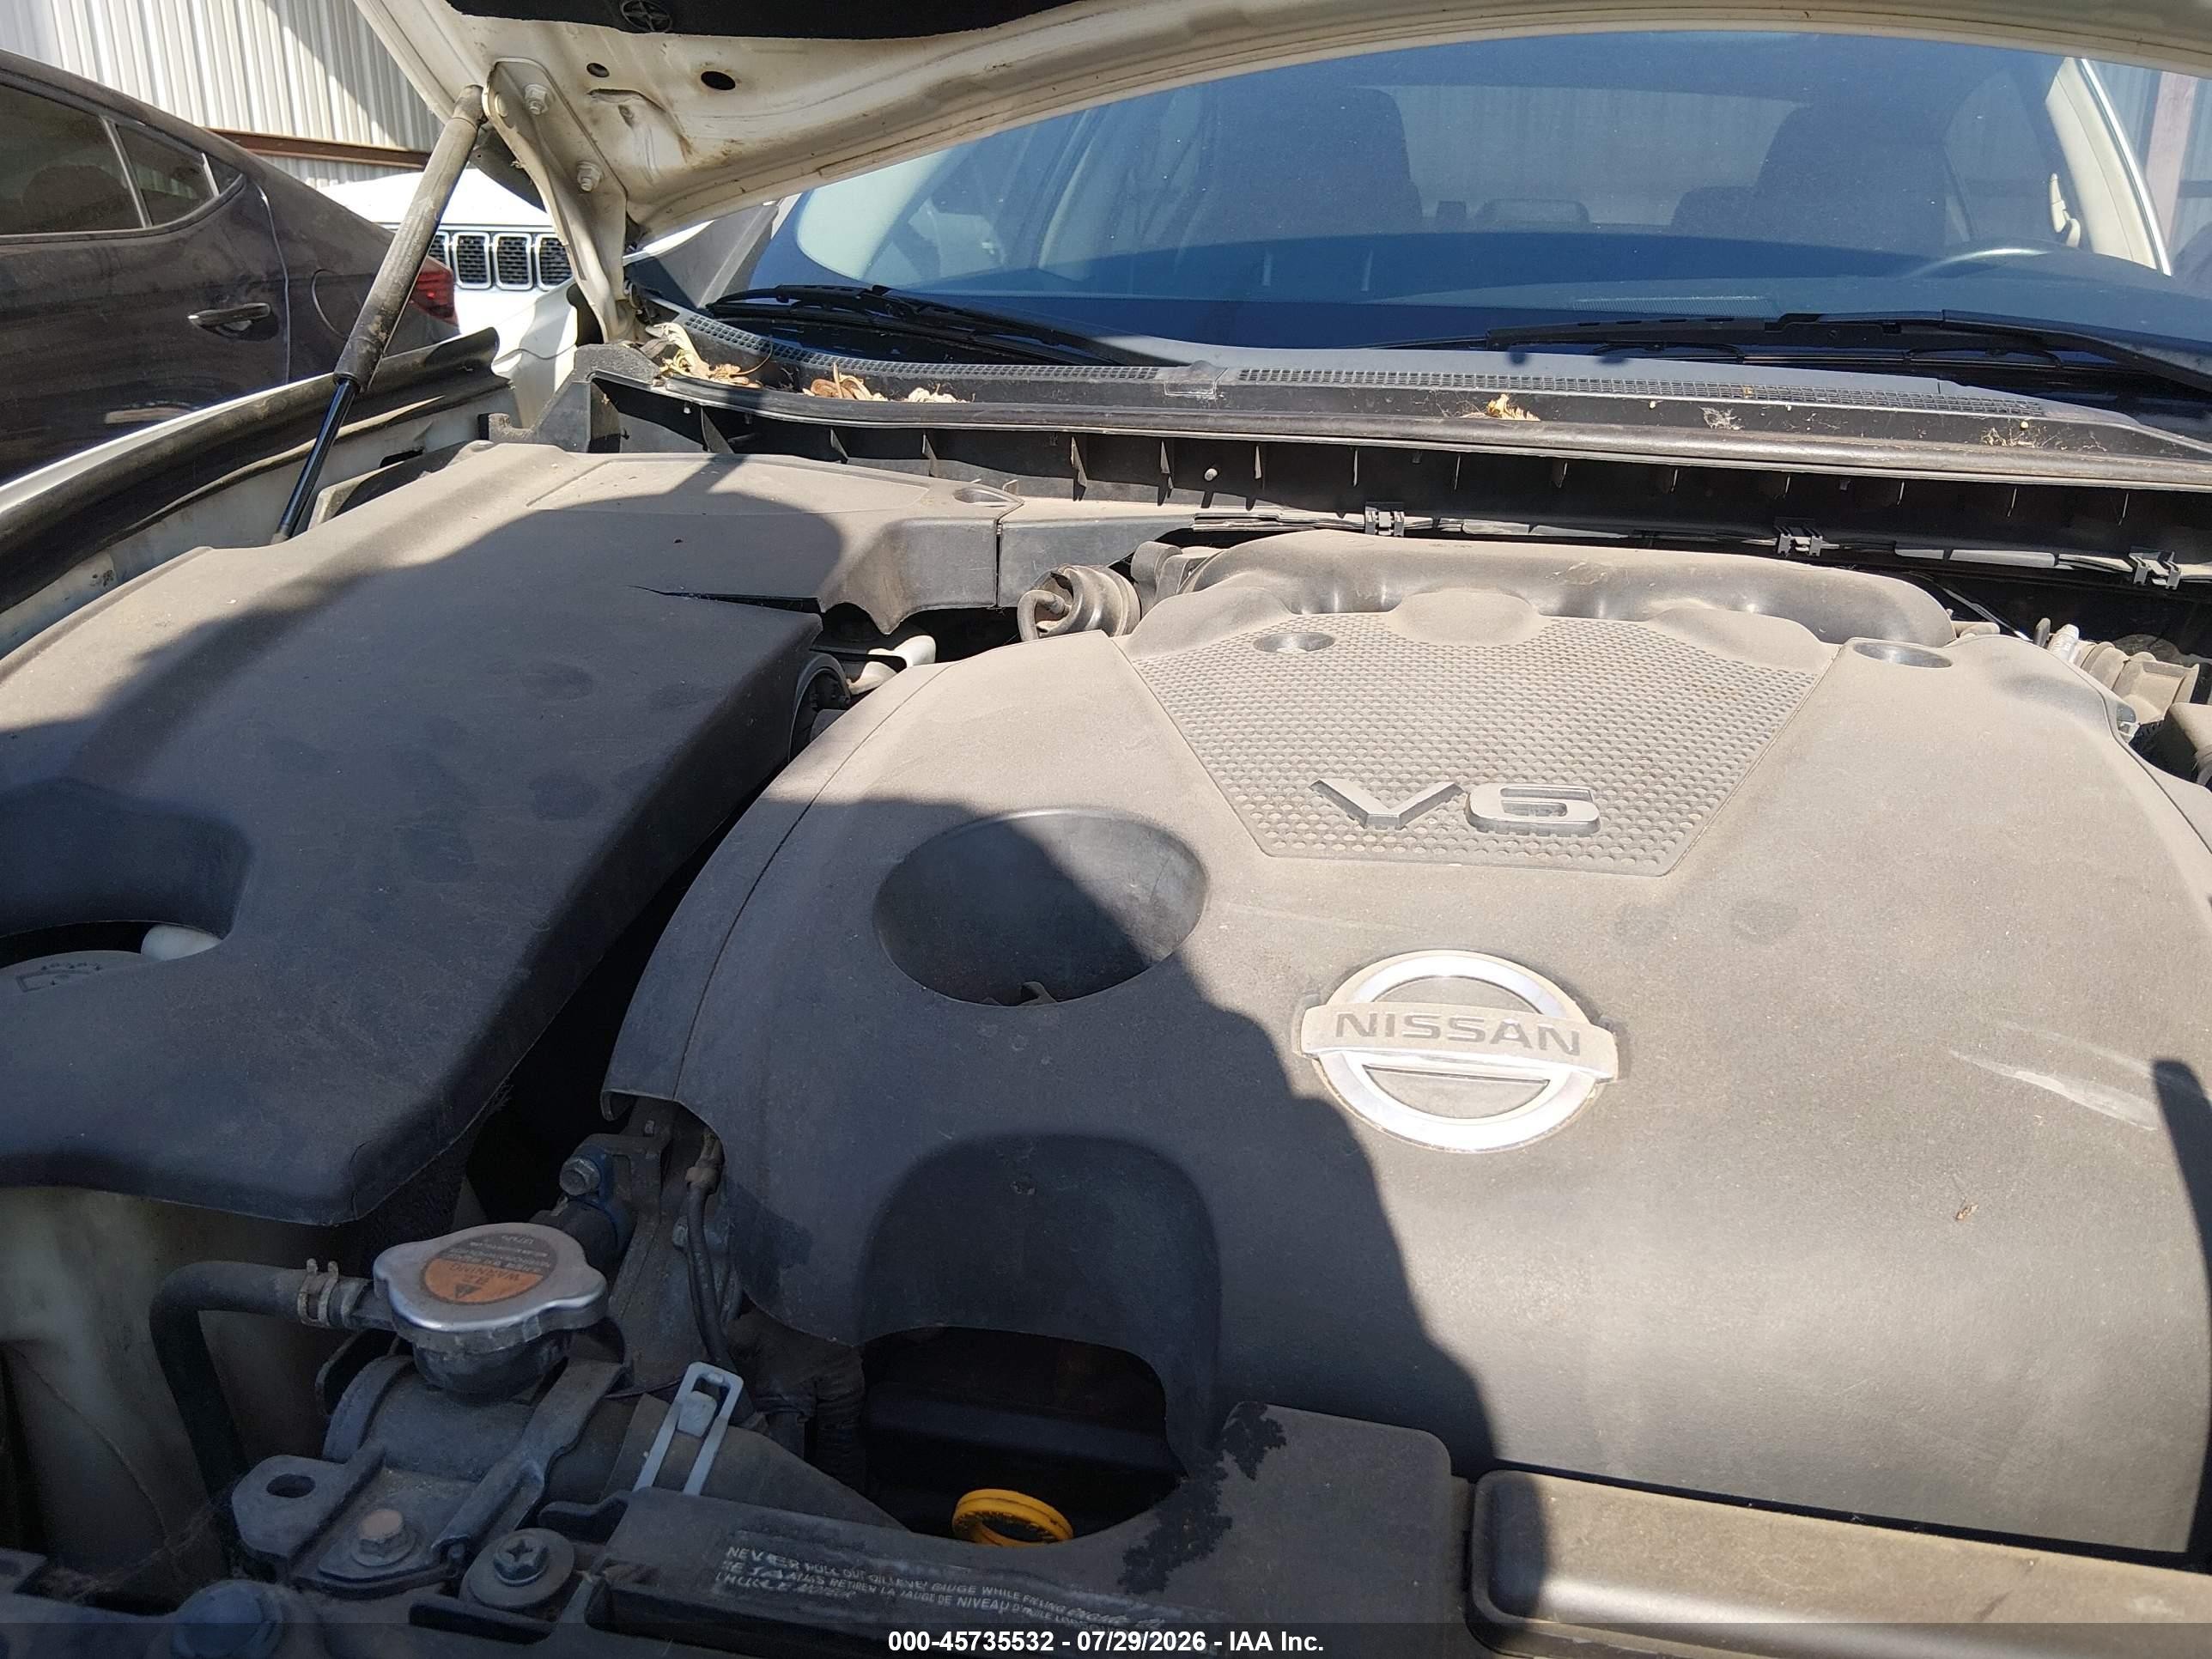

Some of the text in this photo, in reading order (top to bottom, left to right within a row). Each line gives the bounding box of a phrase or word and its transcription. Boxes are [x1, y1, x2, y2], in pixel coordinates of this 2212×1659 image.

[1309, 779, 1601, 837] V6
[1335, 1012, 1581, 1056] NISSAN
[449, 1263, 520, 1282] WARNING
[843, 1568, 866, 1581] OUT
[981, 1585, 1021, 1600] WHILE
[957, 1595, 1010, 1613] NIVEAU
